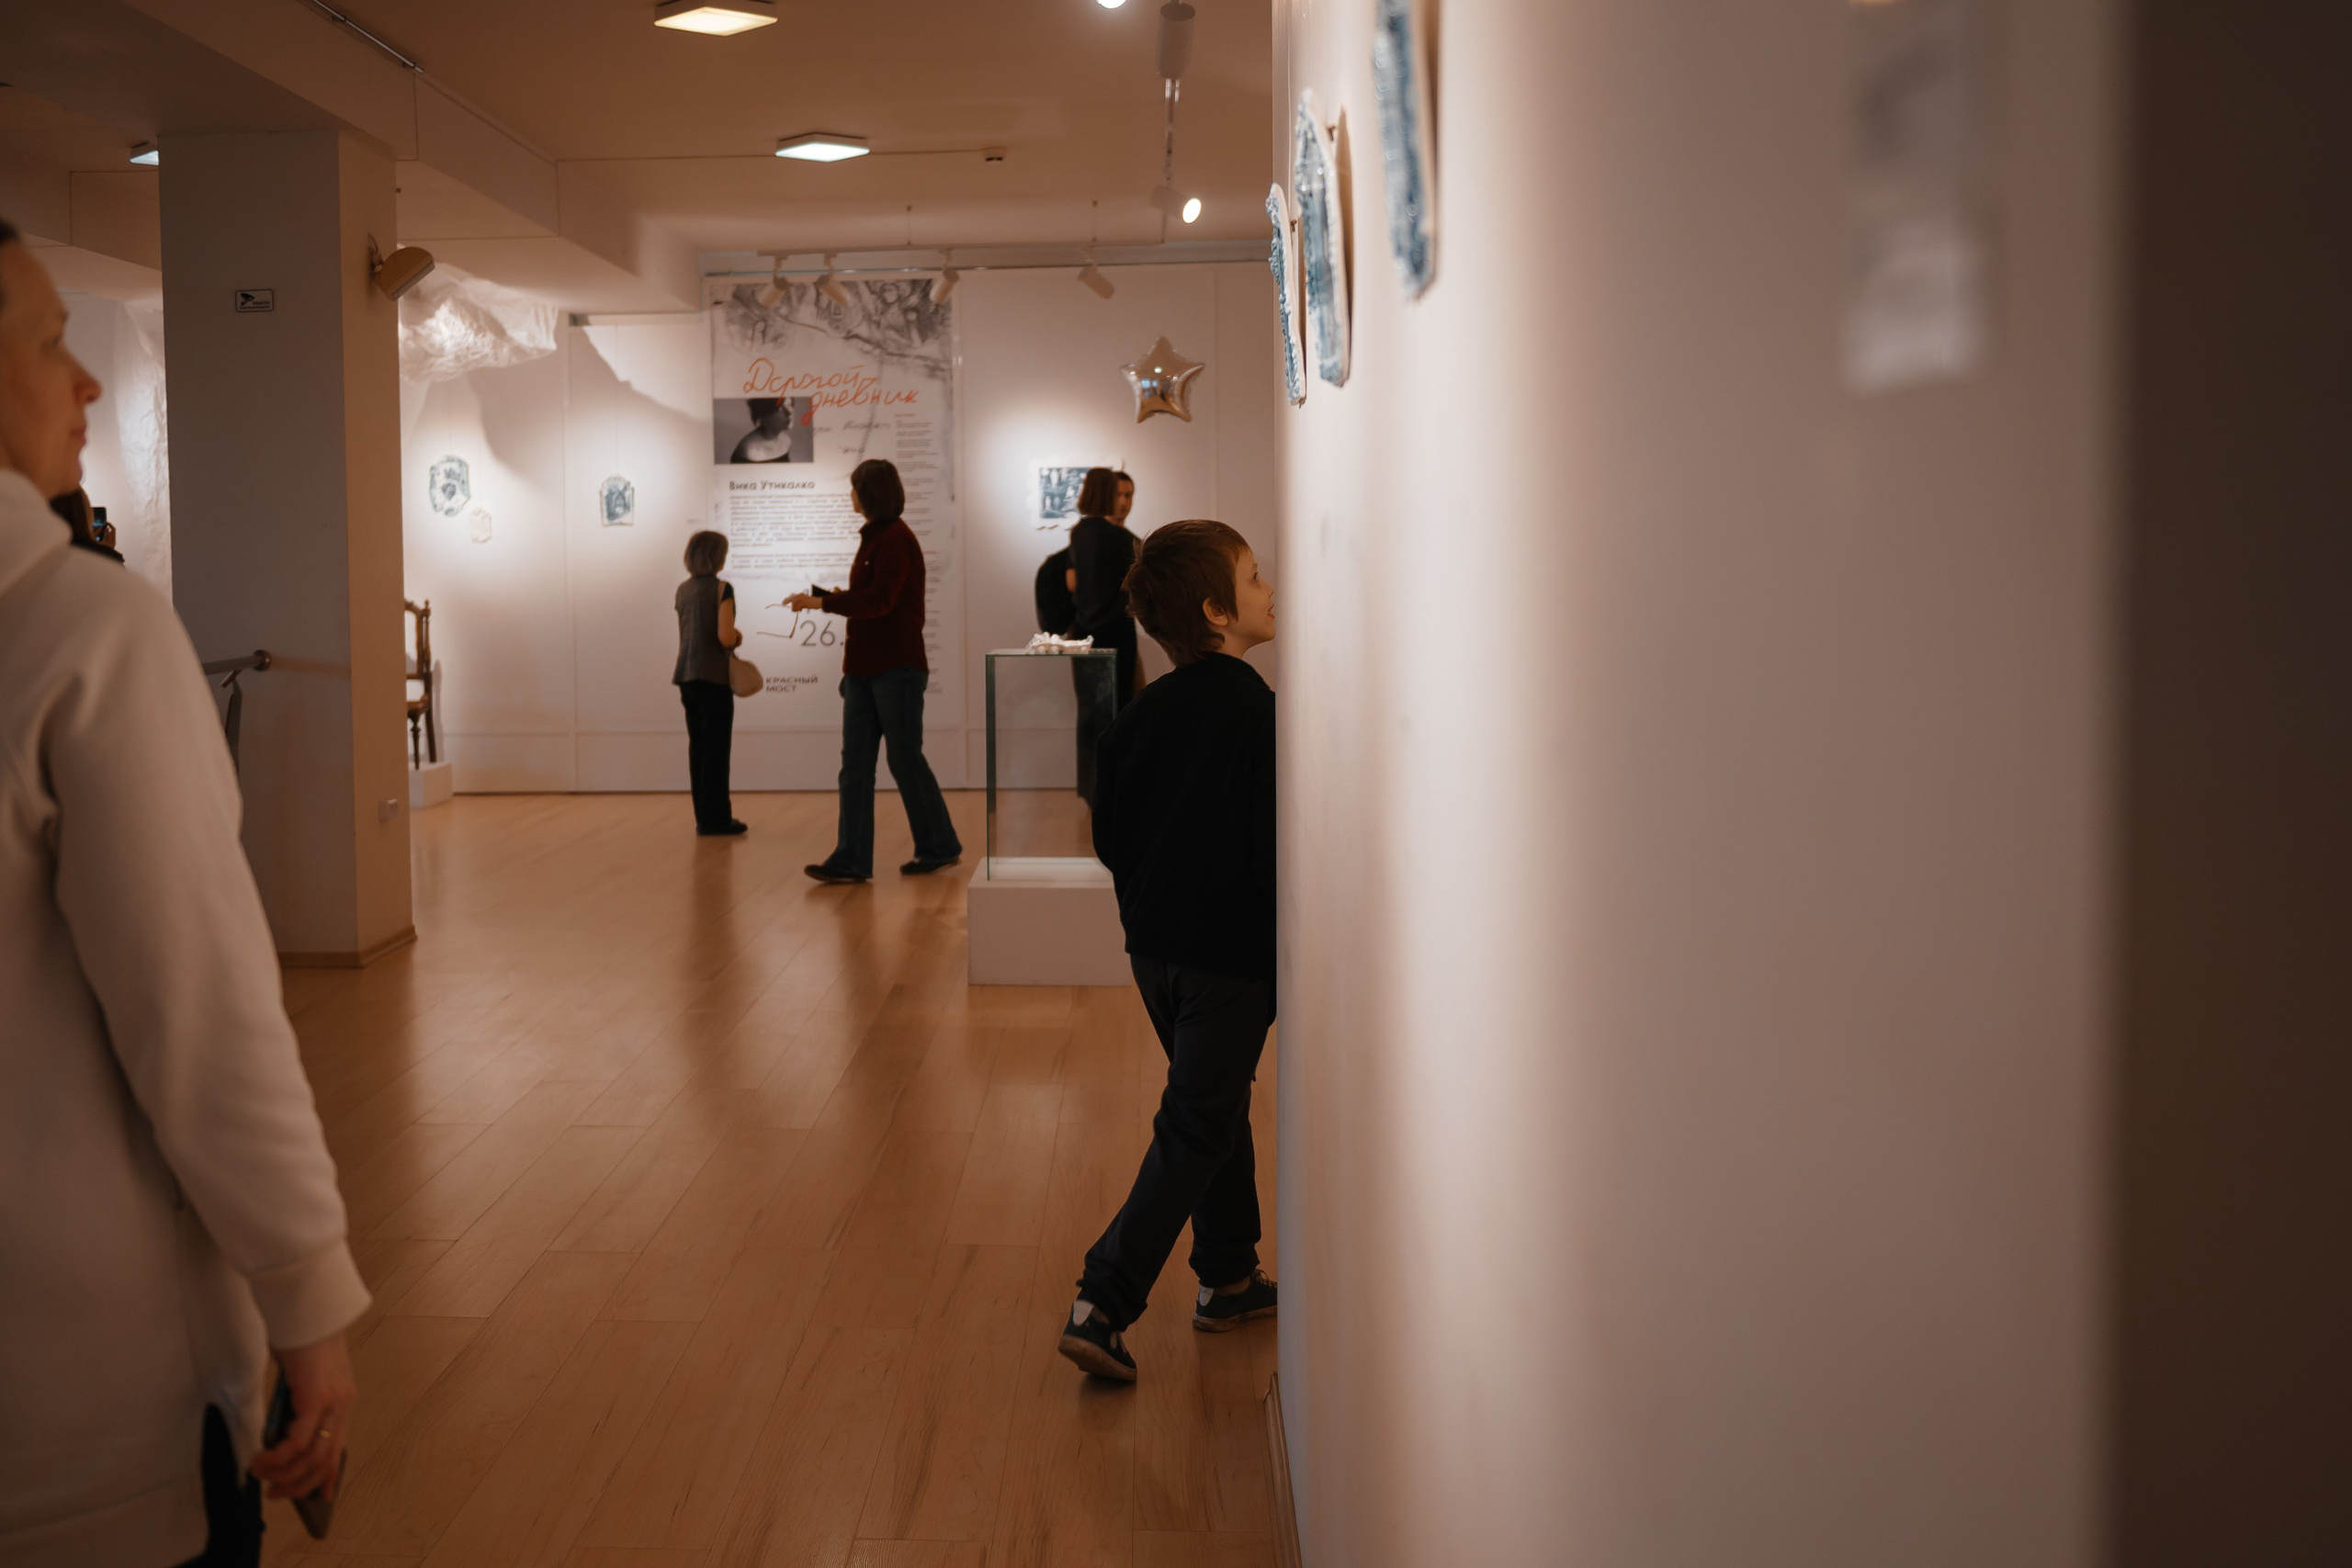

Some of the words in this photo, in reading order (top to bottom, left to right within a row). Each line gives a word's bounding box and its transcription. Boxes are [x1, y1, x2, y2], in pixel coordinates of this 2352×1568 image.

[742, 356, 865, 407] Дорогой
[799, 376, 920, 427] дневник
[729, 479, 757, 491] Вика
[760, 479, 816, 491] Утикалко
[765, 674, 819, 684] КРАСНЫЙ
[765, 684, 797, 693] МОСТ
